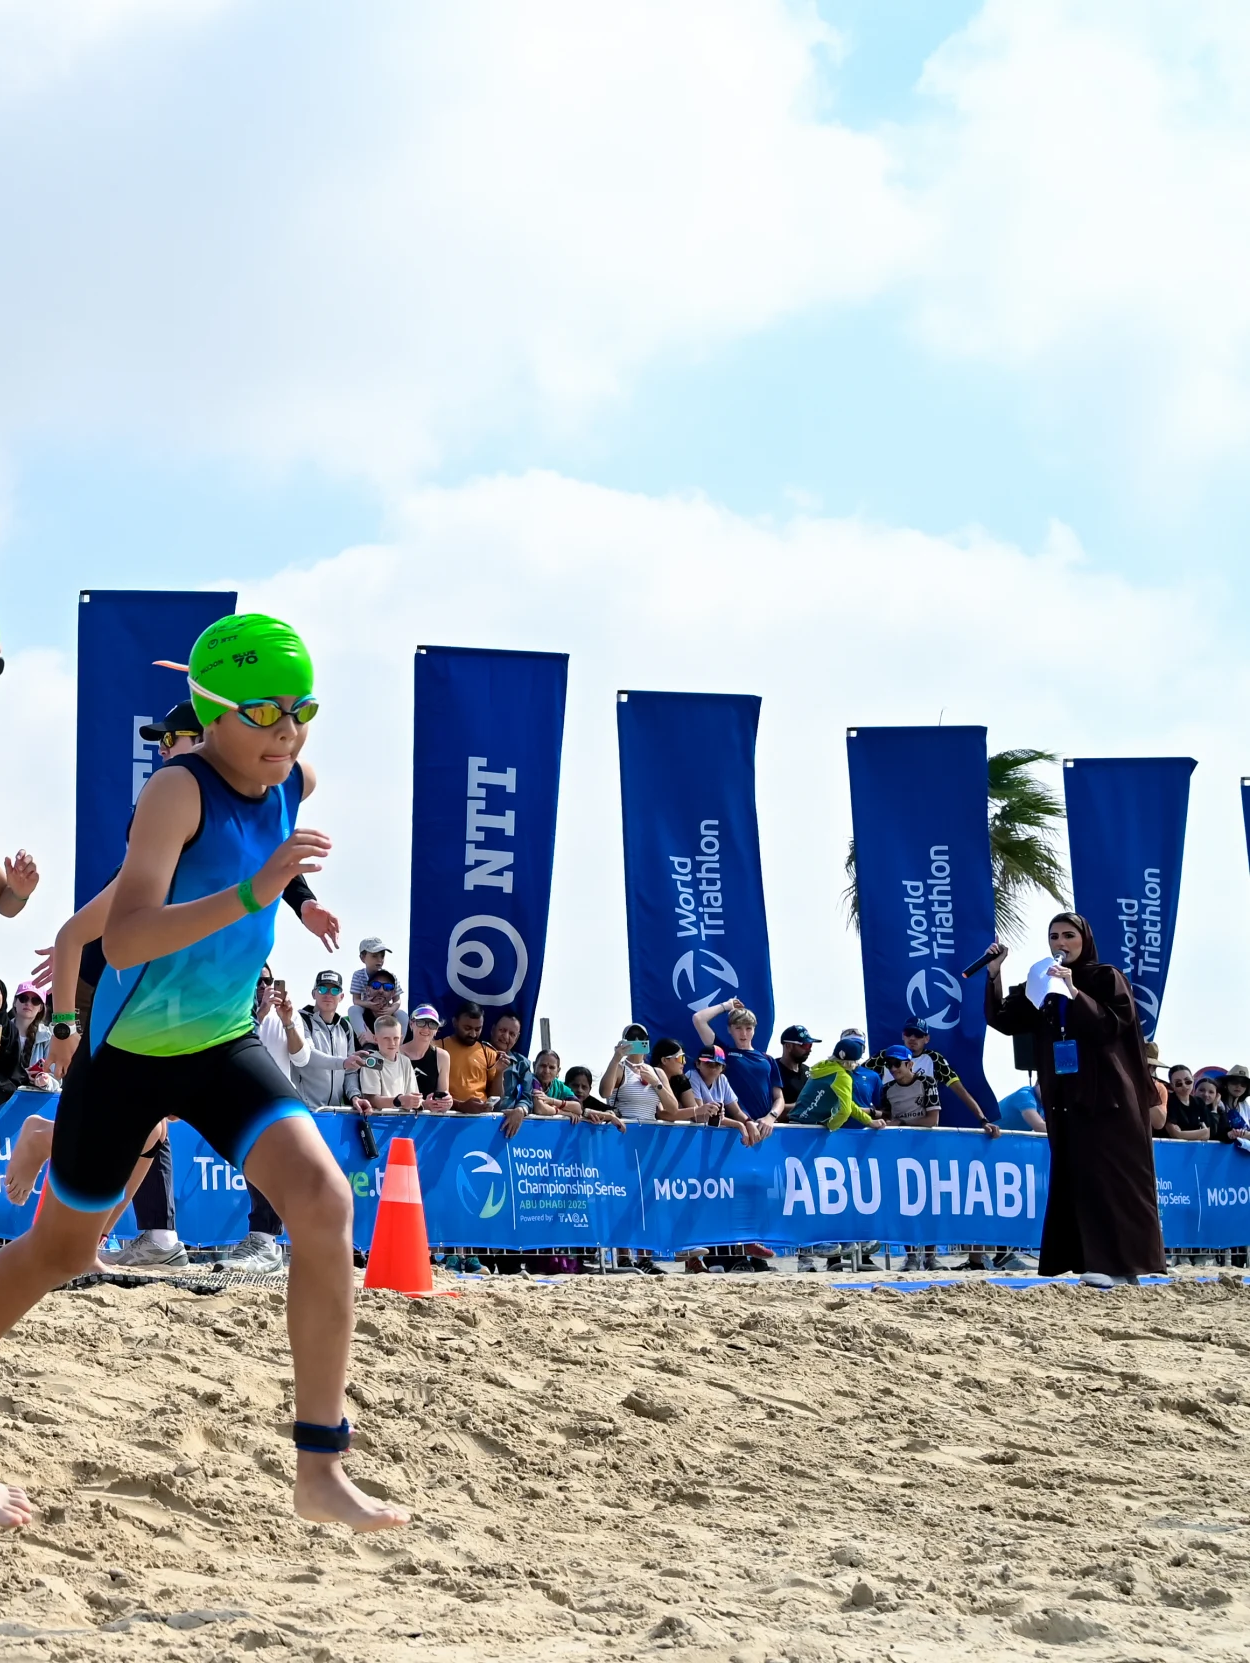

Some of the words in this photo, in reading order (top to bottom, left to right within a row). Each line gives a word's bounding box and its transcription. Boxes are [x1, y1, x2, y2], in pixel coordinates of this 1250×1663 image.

[463, 756, 517, 894] NTT
[669, 855, 699, 938] World
[694, 819, 726, 941] Triathlon
[926, 845, 956, 960] Triathlon
[901, 880, 931, 958] World
[1116, 898, 1139, 974] World
[1137, 867, 1162, 977] Triathlon
[515, 1162, 550, 1177] World
[550, 1163, 600, 1179] Triathlon
[518, 1179, 594, 1198] Championship
[594, 1182, 627, 1197] Series
[519, 1199, 538, 1210] ABU
[539, 1199, 566, 1210] DHABI
[568, 1200, 587, 1210] 2025
[782, 1156, 882, 1216] ABU
[896, 1157, 1037, 1219] DHABI
[1169, 1192, 1191, 1205] Series
[519, 1214, 545, 1222] Powered
[557, 1212, 589, 1223] TAQA
